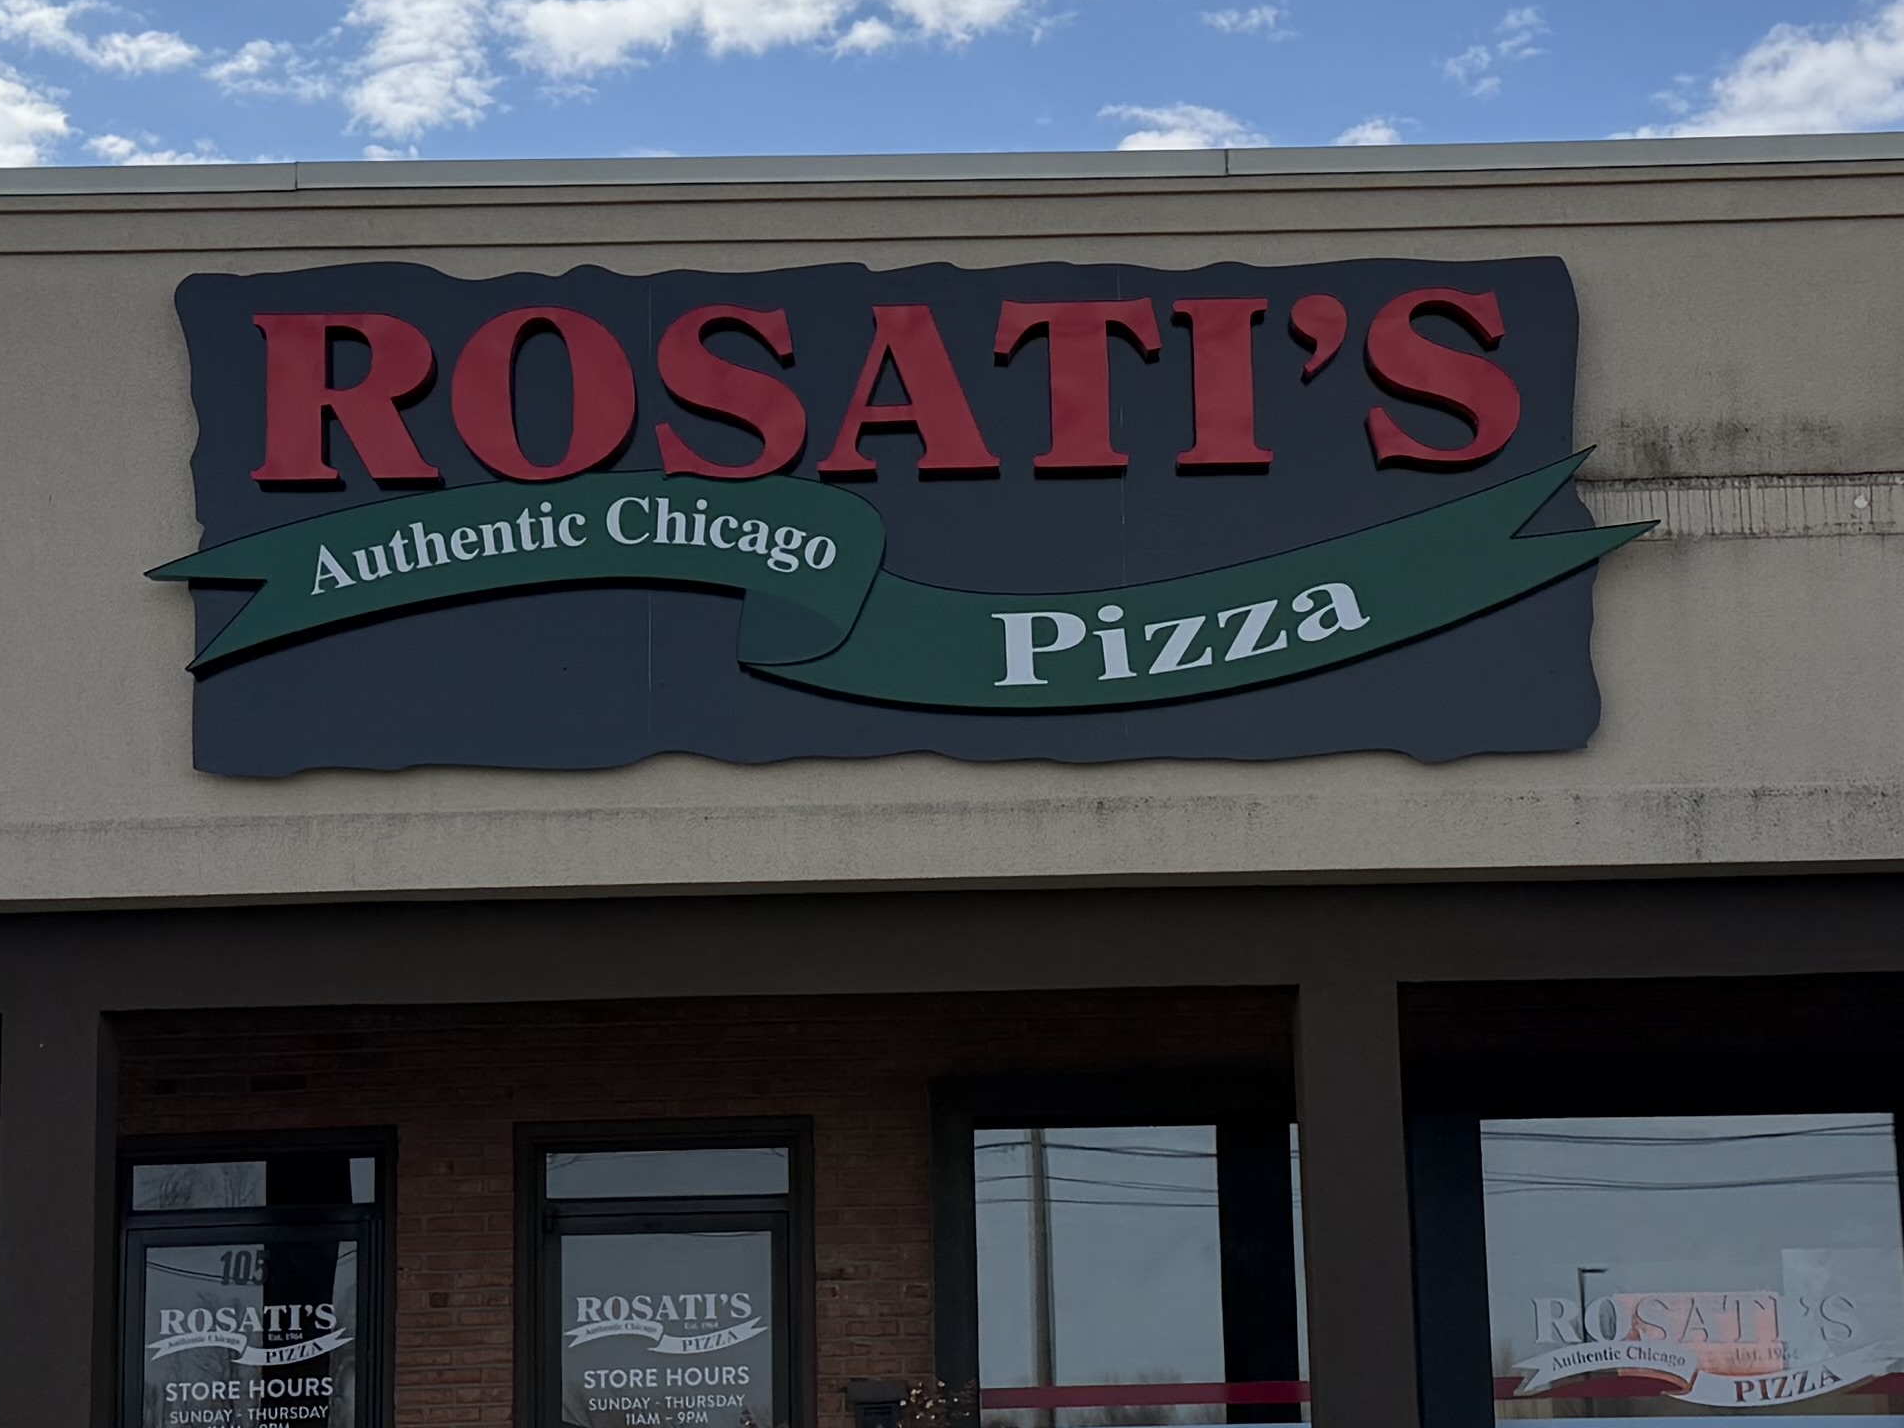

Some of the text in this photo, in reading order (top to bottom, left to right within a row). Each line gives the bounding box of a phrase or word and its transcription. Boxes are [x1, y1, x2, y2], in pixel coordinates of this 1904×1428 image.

[251, 287, 1521, 489] ROSATI'S
[309, 492, 840, 597] Authentic Chicago
[993, 580, 1370, 688] Pizza
[220, 1249, 270, 1286] 105
[159, 1303, 337, 1336] ROSATI'S
[575, 1292, 752, 1322] ROSATI'S
[1531, 1293, 1855, 1345] ROSATI'S
[266, 1341, 323, 1363] PIZZA
[682, 1330, 738, 1352] PIZZA
[1551, 1345, 1686, 1371] Authentic Chicago
[165, 1377, 334, 1402] STORE HOURS
[584, 1366, 750, 1389] STORE HOURS
[1734, 1363, 1843, 1404] PIZZA
[169, 1409, 233, 1424] SUNDAY
[248, 1405, 329, 1421] THURSDAY
[588, 1397, 651, 1412] SUNDAY
[665, 1394, 745, 1409] THURSDAY
[625, 1412, 660, 1425] 11AM
[677, 1410, 709, 1424] 9PM
